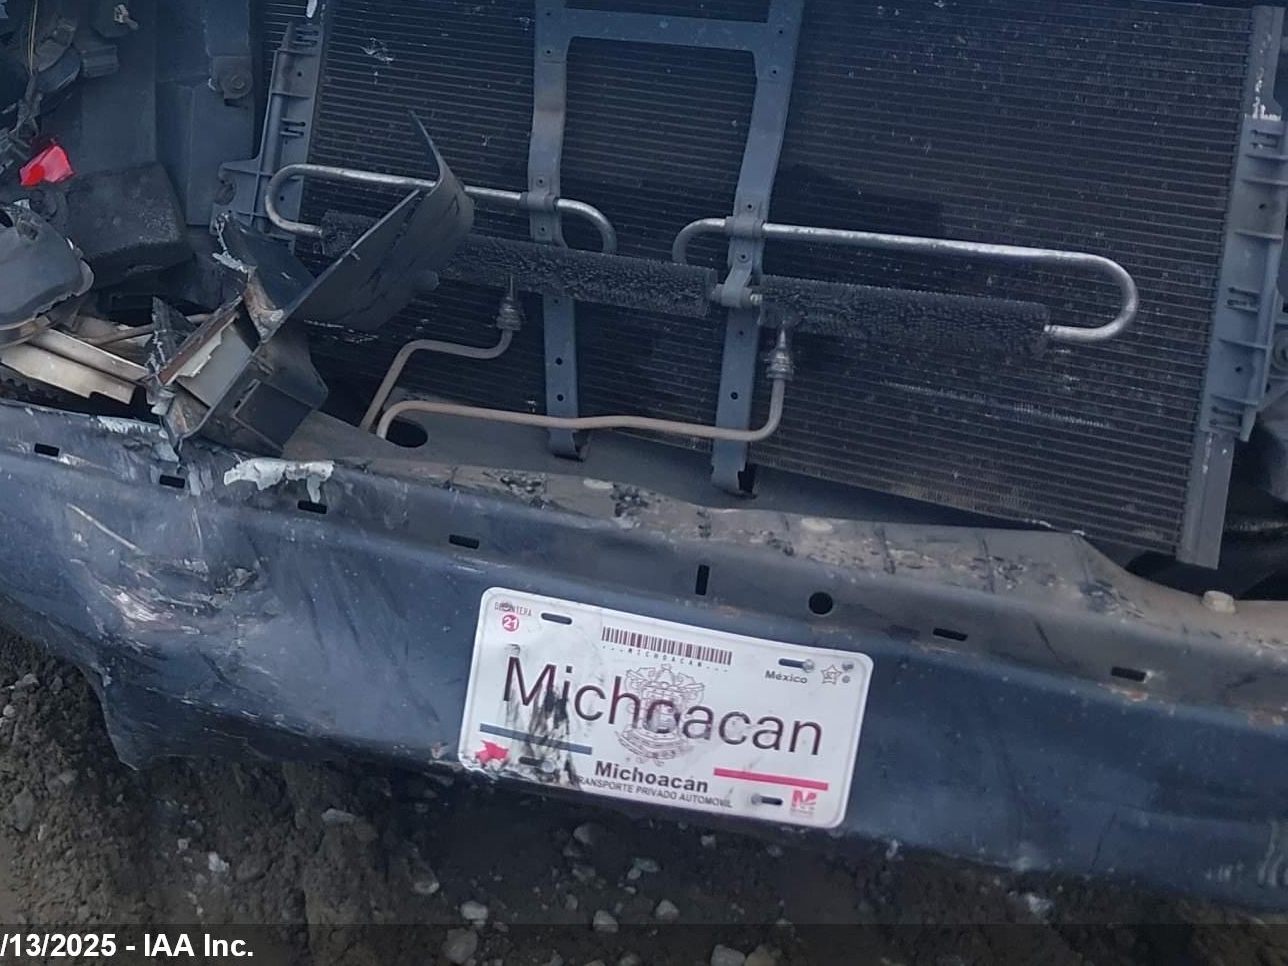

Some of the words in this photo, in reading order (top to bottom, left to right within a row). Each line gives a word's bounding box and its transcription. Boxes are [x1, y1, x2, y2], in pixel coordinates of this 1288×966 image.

[503, 656, 824, 756] Michoacan
[574, 775, 634, 794] RANSPORTE
[636, 784, 677, 801] PRIVADO
